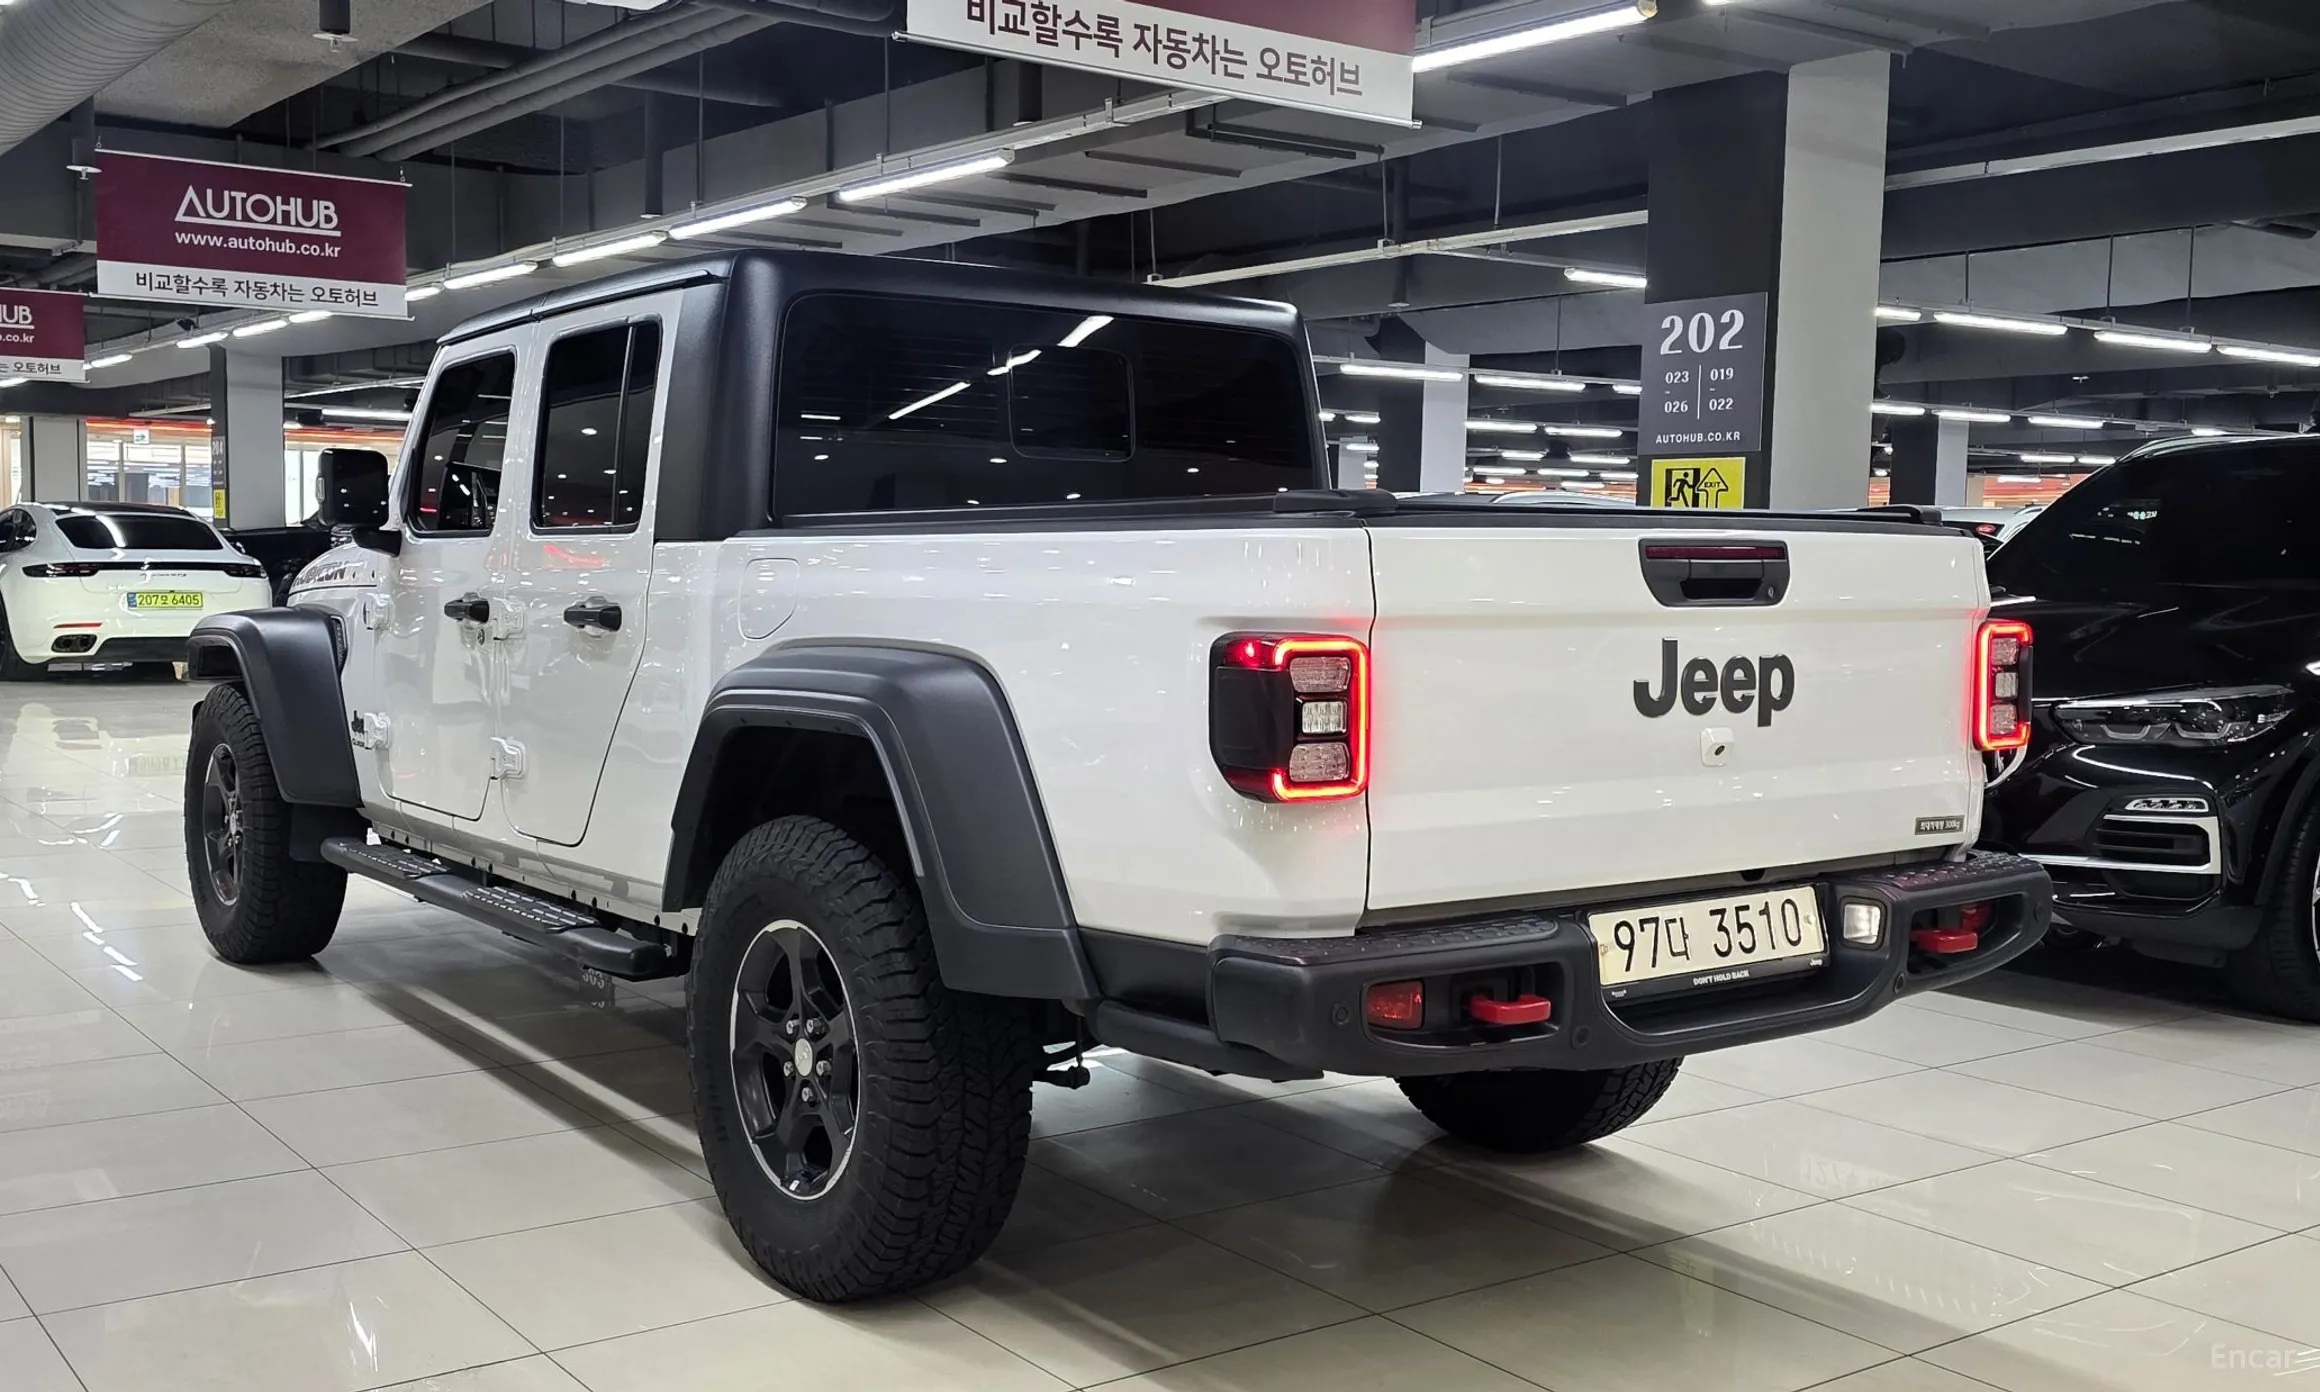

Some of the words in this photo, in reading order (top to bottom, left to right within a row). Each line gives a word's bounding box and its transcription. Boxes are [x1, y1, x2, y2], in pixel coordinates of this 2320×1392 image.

[967, 0, 1123, 58] 비교할수록
[1132, 23, 1248, 80] 자동차는
[1255, 47, 1363, 96] 오토허브
[174, 184, 341, 233] AUTOHUB
[174, 231, 342, 258] www.autohub.co.kr
[136, 272, 229, 297] 비교할수록
[234, 279, 305, 303] 자동차는
[310, 286, 379, 307] 오토허브
[0, 304, 33, 324] UB
[1660, 309, 1745, 355] 202
[12, 361, 62, 375] 오토허브
[1710, 367, 1734, 381] 019
[1665, 370, 1690, 384] 023
[1664, 400, 1689, 413] 026
[1708, 397, 1734, 411] 022
[1655, 430, 1741, 444] AUTOHUB.CO.KR
[171, 594, 200, 606] 6405
[1633, 637, 1795, 728] Jeep
[1613, 916, 1690, 973] 97다
[1709, 898, 1802, 958] 3510
[1713, 972, 1731, 983] HOLD
[1731, 969, 1750, 980] BACK
